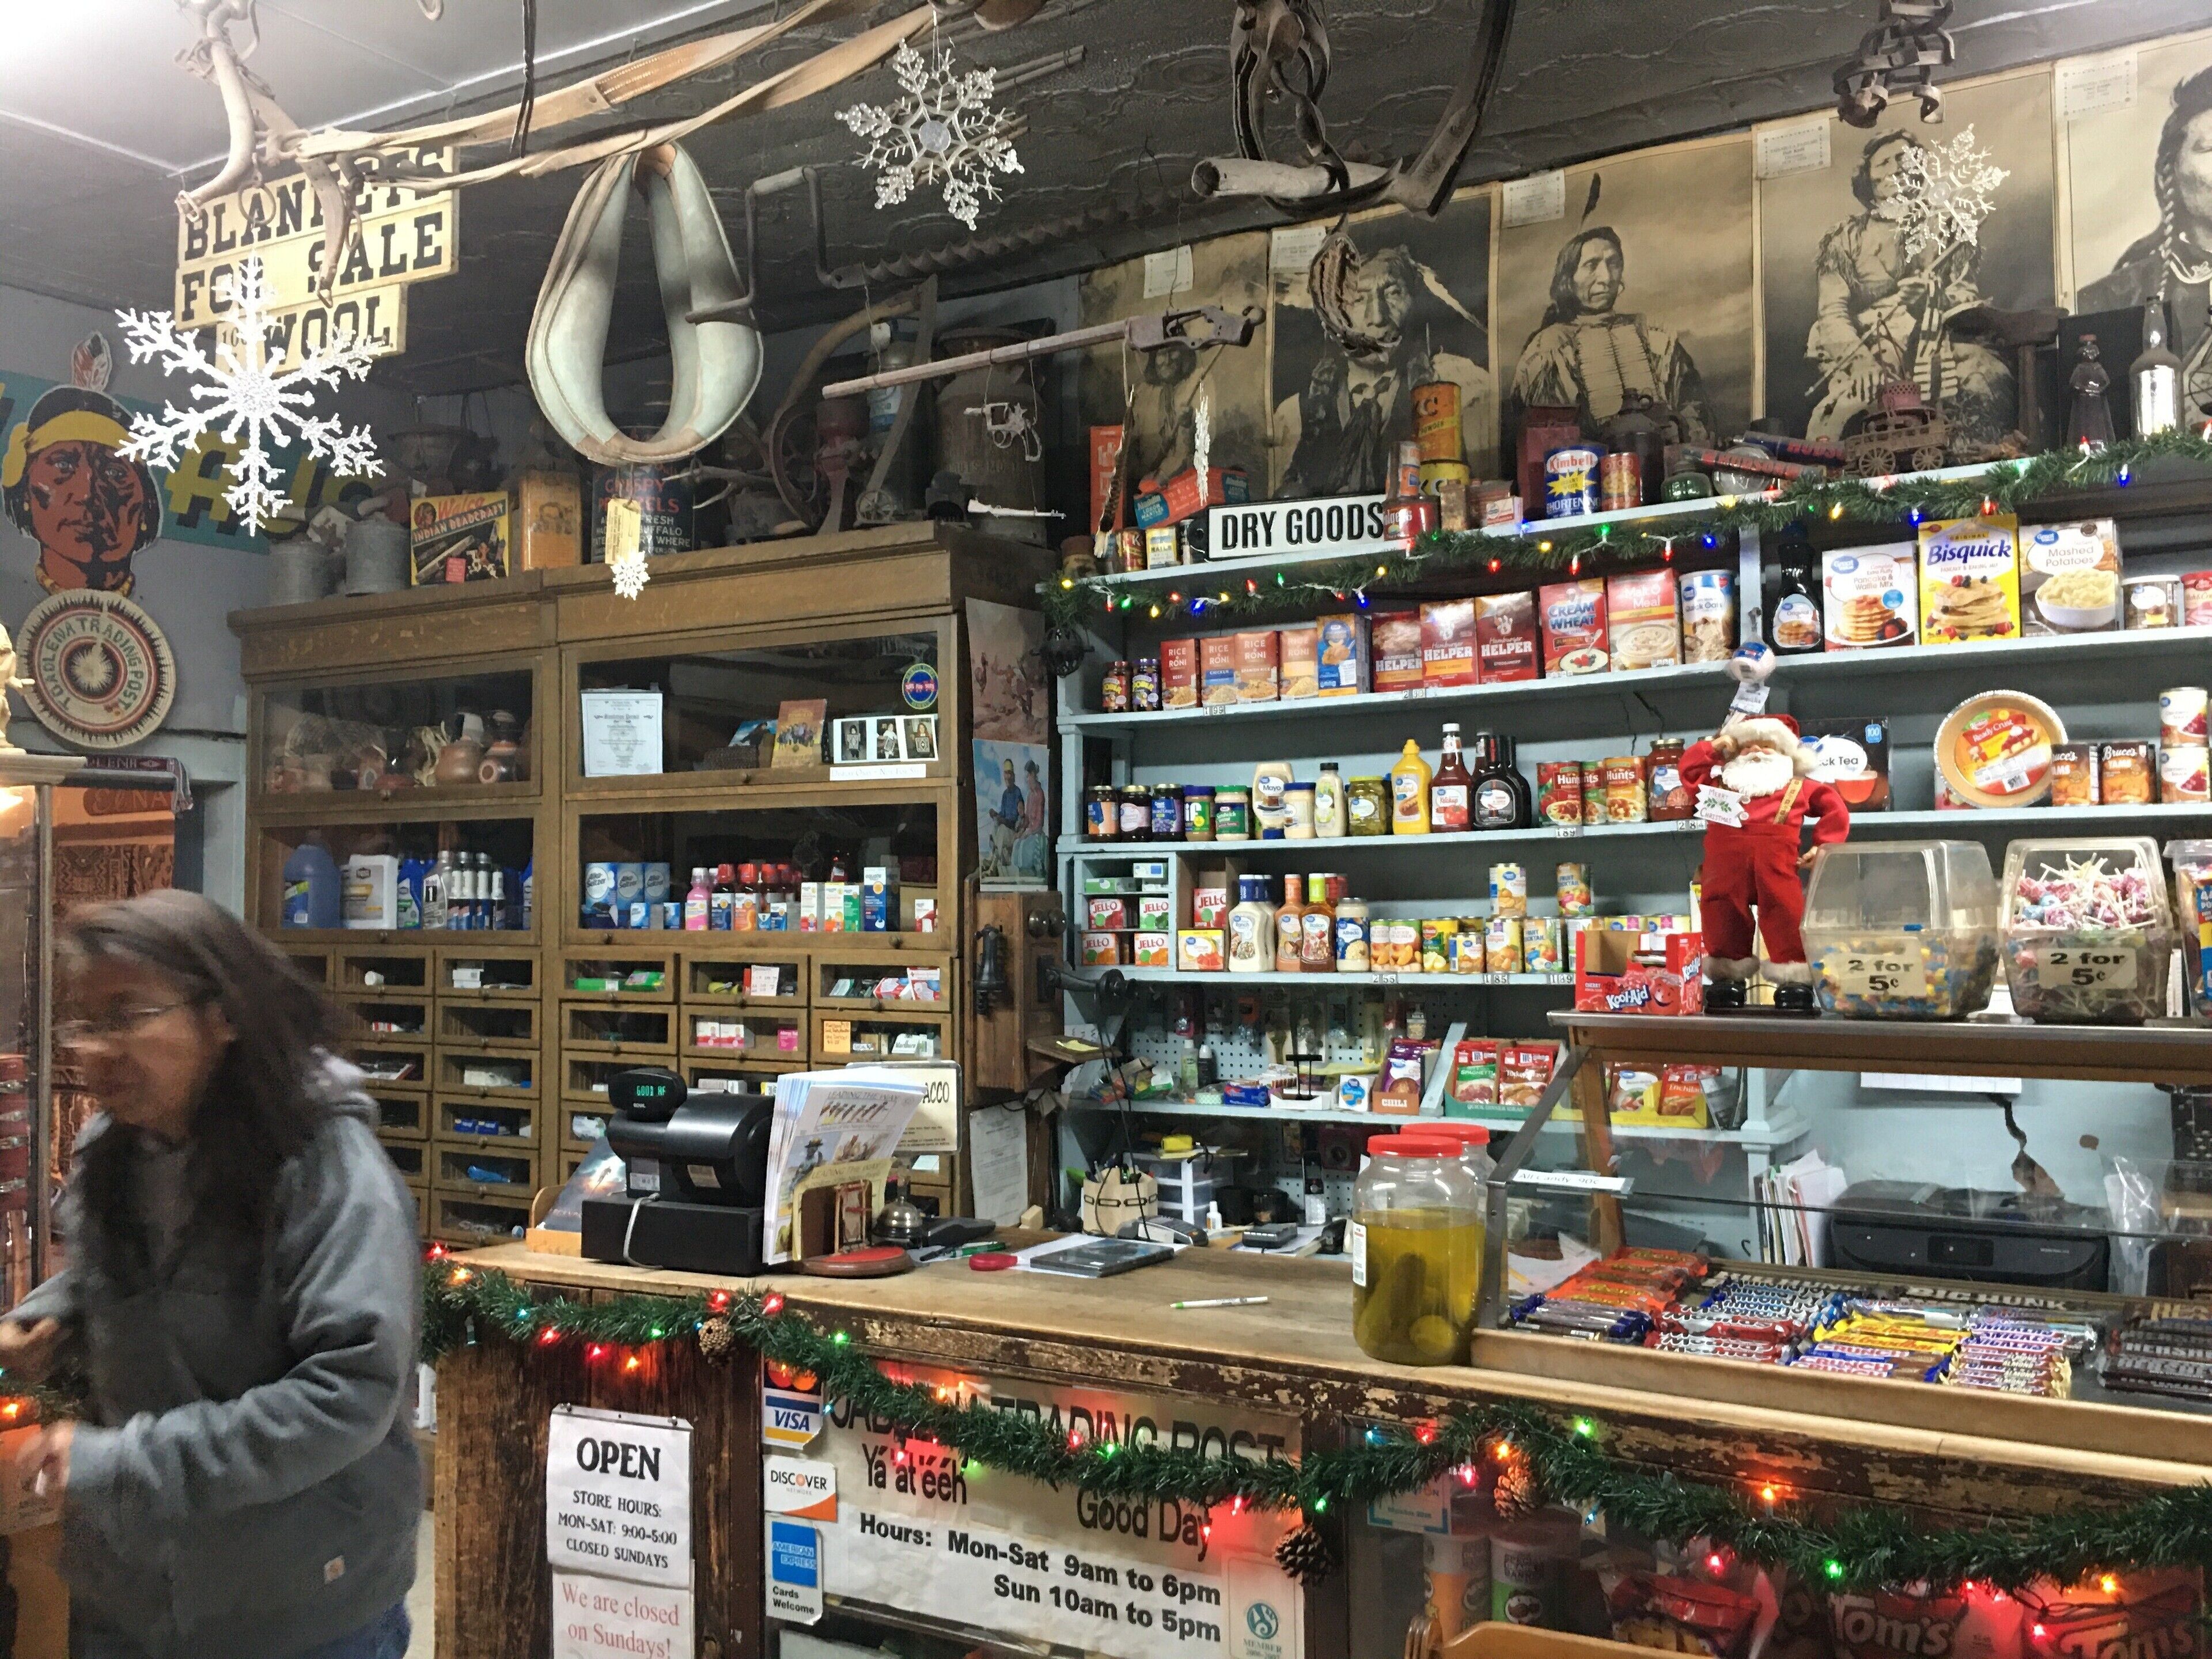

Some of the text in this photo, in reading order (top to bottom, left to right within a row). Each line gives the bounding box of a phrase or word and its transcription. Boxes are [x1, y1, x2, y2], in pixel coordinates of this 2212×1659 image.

[1221, 501, 1384, 551] DRY GOODS
[1927, 539, 2012, 566] Bisquick
[2048, 546, 2094, 557] Mashed
[2046, 555, 2094, 567] Potatoes
[1549, 602, 1594, 618] CREAM
[1633, 597, 1661, 609] Meal
[1550, 614, 1595, 629] WHEAT
[1209, 645, 1229, 653] RICE
[1244, 639, 1266, 648] RICE
[1481, 641, 1532, 656] HELPER
[1168, 647, 1186, 656] RICE
[1423, 646, 1473, 661] HELPER
[1376, 658, 1422, 672] HELPER
[1838, 756, 1858, 766] Tea
[2051, 764, 2071, 775] AMS
[1263, 785, 1282, 793] Mayo
[1699, 809, 1733, 824] CHRISTMAS
[2050, 950, 2126, 965] 2 for
[1847, 959, 1914, 974] 2 for
[1606, 984, 1650, 1010] Kool-Aid
[1669, 1083, 1703, 1094] Enchila
[1381, 1099, 1407, 1108] CHILI
[774, 1409, 810, 1432] VISA
[576, 1437, 661, 1482] OPEN
[770, 1469, 828, 1491] DISCOVER
[572, 1490, 662, 1518] STORE HOURS:
[558, 1512, 677, 1546] MON-SAT: 9:00-5:00
[1077, 1489, 1213, 1563] Good Day
[566, 1537, 669, 1569] CLOSED SUNDAYS
[772, 1540, 815, 1558] AMERICAN
[780, 1554, 817, 1571] EXPRESS
[860, 1512, 1221, 1607] Hours: Mon-Sat 9am to 6pm
[772, 1585, 800, 1600] Cards
[562, 1582, 680, 1627] We are closed
[772, 1598, 815, 1615] Welcome
[994, 1574, 1221, 1643] Sun 10am to 5pm
[1827, 1591, 1955, 1655] Tom's
[567, 1623, 672, 1659] on Sundays!
